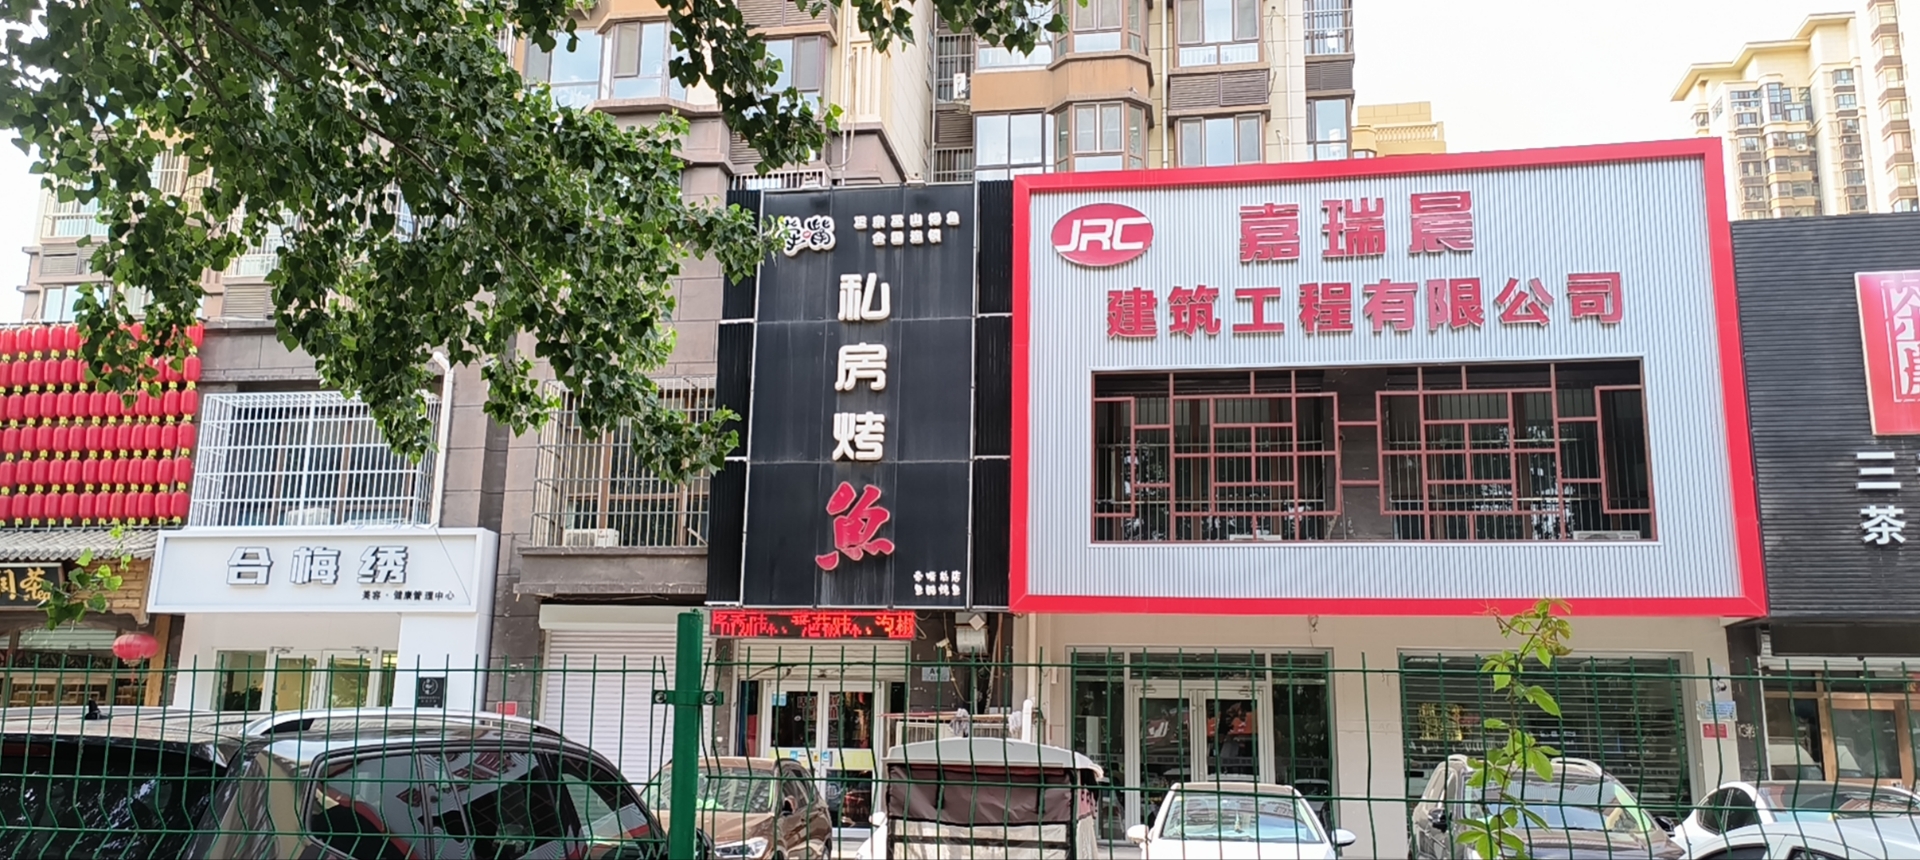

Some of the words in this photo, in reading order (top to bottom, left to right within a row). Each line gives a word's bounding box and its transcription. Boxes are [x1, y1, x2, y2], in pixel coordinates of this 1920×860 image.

[1055, 217, 1154, 252] JRC
[1239, 191, 1475, 262] 嘉瑞晨
[1107, 272, 1625, 339] 建筑工程有限公司
[226, 546, 408, 585] 合梅绣
